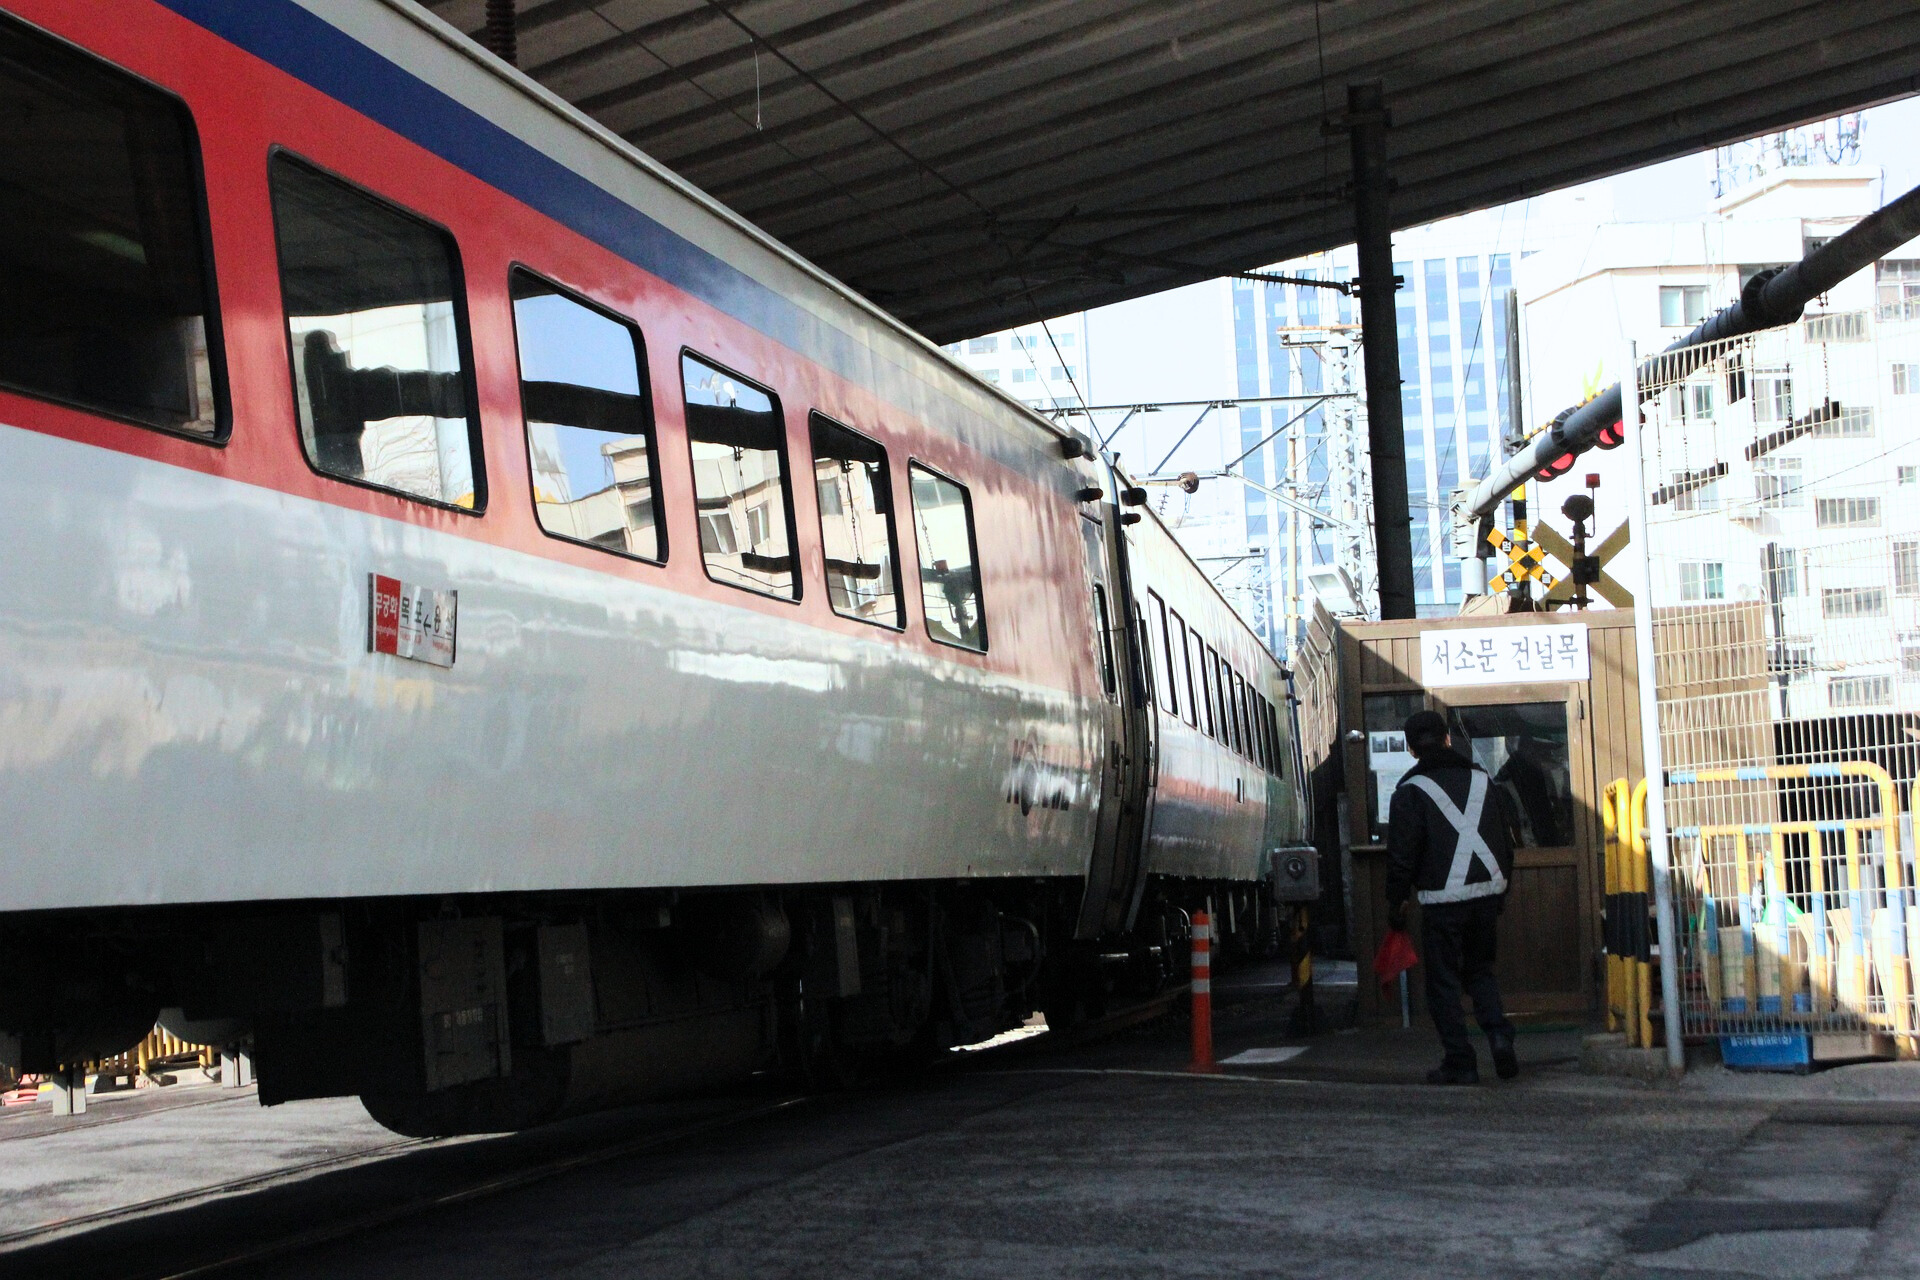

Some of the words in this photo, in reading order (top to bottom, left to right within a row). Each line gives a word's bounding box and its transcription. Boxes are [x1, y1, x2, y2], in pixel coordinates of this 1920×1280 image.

[376, 591, 398, 620] 무궁화
[1432, 638, 1498, 675] 서소문
[1511, 633, 1578, 671] 건널목
